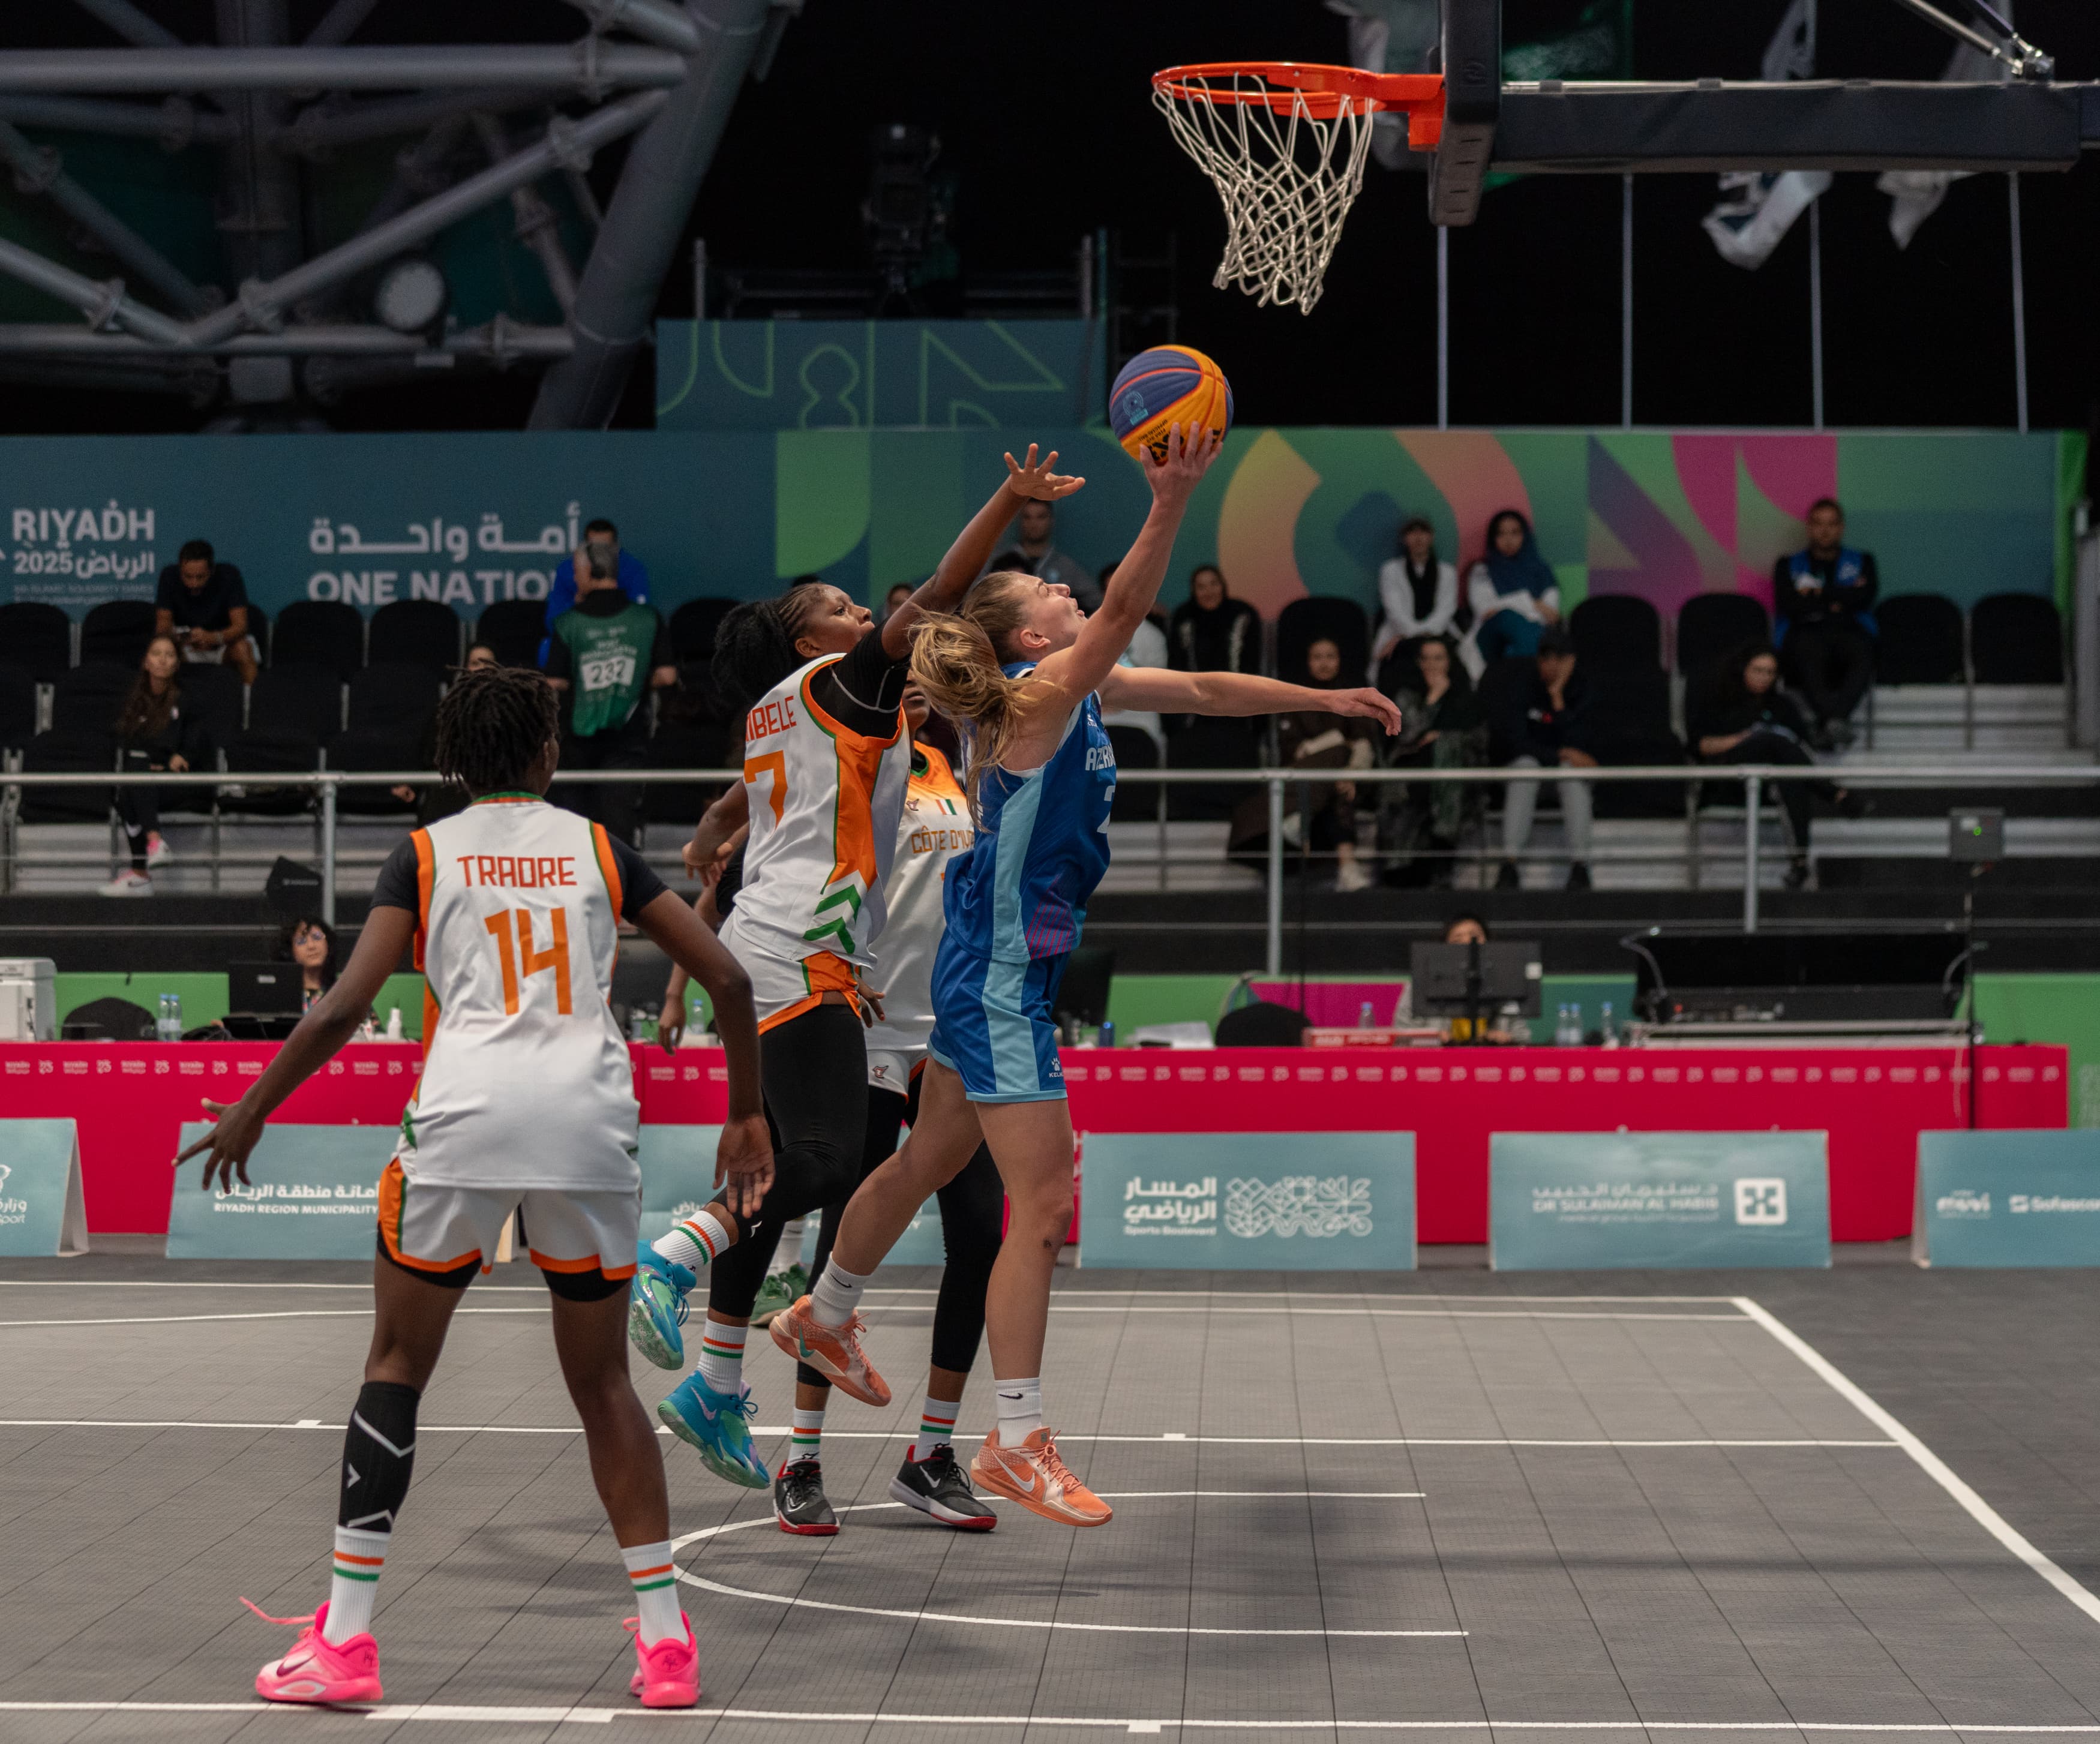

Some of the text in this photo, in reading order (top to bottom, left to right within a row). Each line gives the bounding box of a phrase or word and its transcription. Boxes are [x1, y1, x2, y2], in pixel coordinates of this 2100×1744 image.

[13, 508, 154, 542] RIYADH
[309, 501, 581, 563] أمة واحدة
[14, 551, 73, 574] 2025
[76, 550, 155, 580] الرياض
[308, 571, 557, 605] ONE NATIO
[592, 661, 626, 684] 232
[744, 750, 788, 833] 7
[911, 826, 946, 854] CÔTE
[457, 855, 577, 888] TRAORE
[484, 907, 572, 1016] 14
[277, 1184, 332, 1198] منطقة
[1124, 1176, 1217, 1200] المسار
[215, 1203, 378, 1214] RIYADH REGION MUNICIPALITY
[1124, 1200, 1217, 1224] الرياضي
